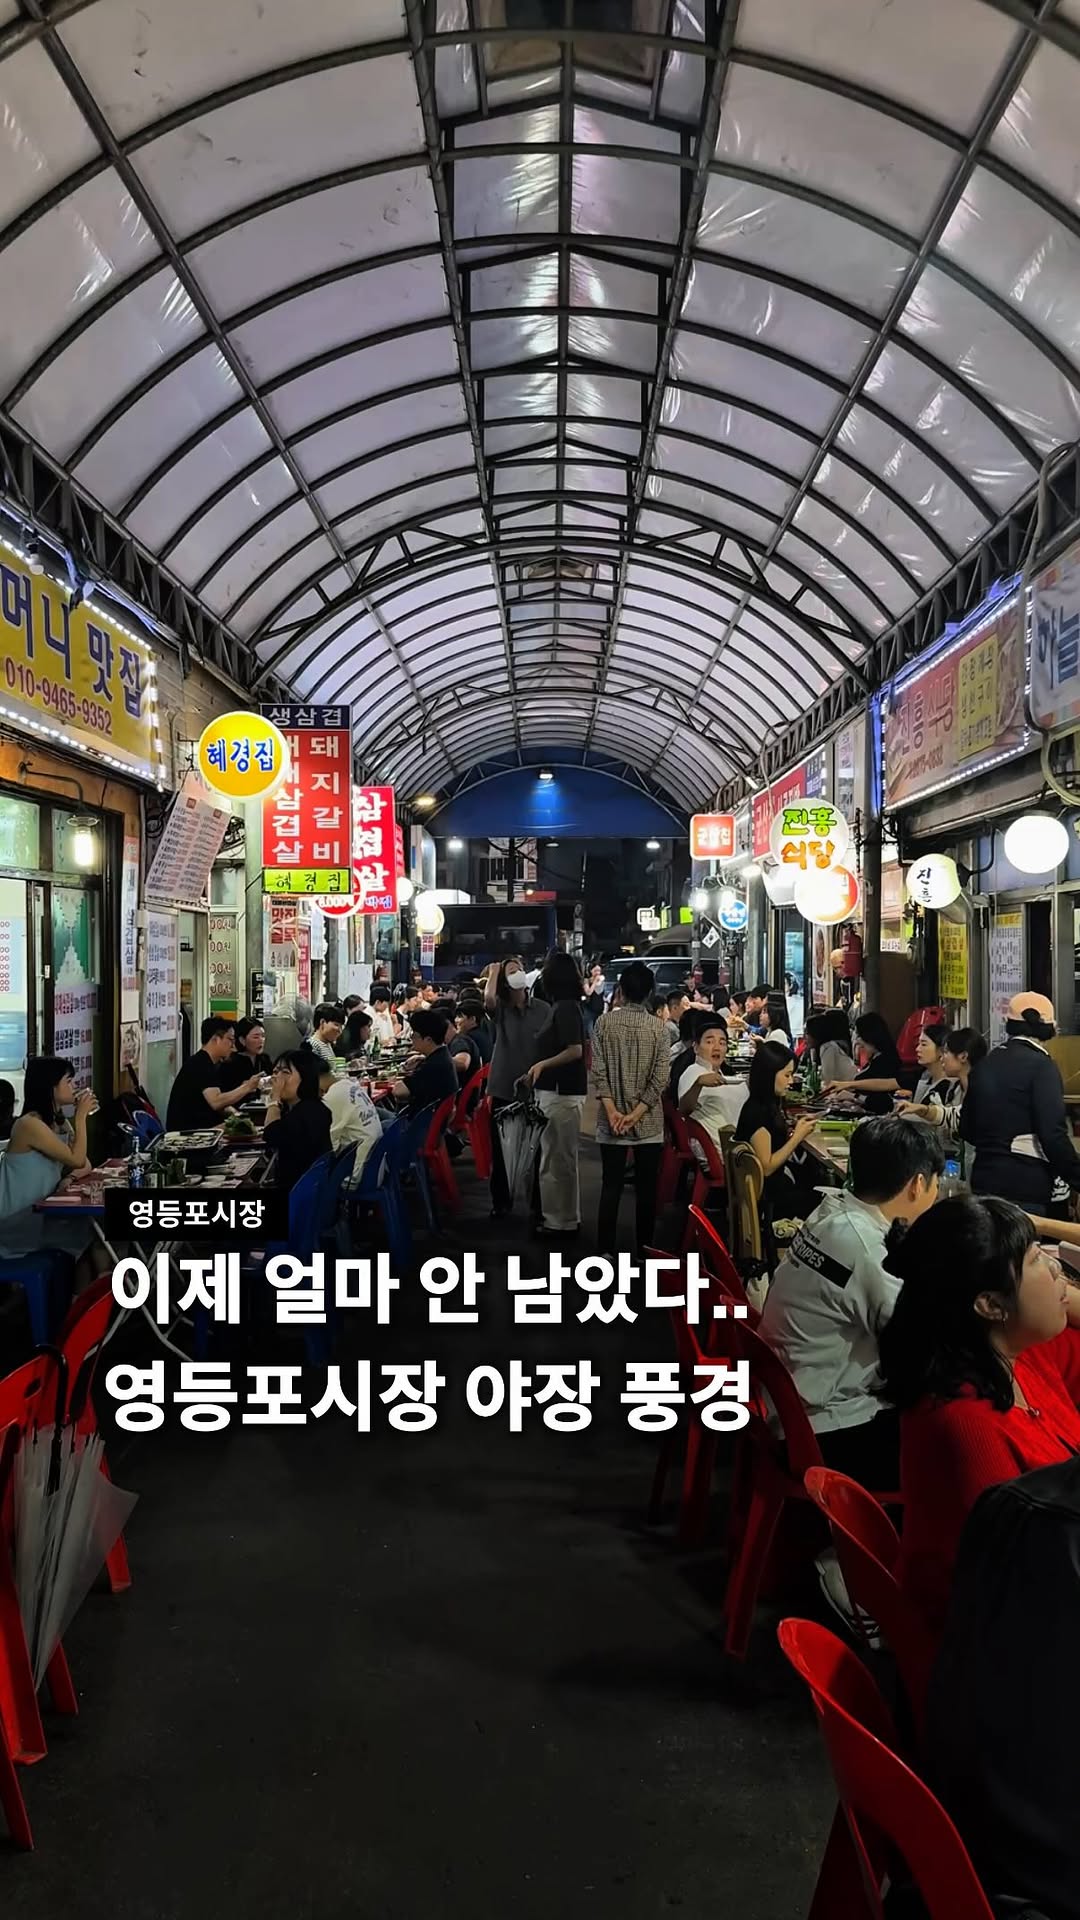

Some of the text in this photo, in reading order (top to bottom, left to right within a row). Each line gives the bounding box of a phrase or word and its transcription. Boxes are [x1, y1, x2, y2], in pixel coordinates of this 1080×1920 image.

[86, 622, 143, 718] 맛집
[5, 656, 113, 737] 010-9465-9352
[268, 706, 344, 727] 생삼겹
[205, 738, 275, 773] 혜경집
[309, 735, 344, 865] 돼지갈비
[781, 806, 837, 837] 진흥
[781, 840, 835, 870] 식당
